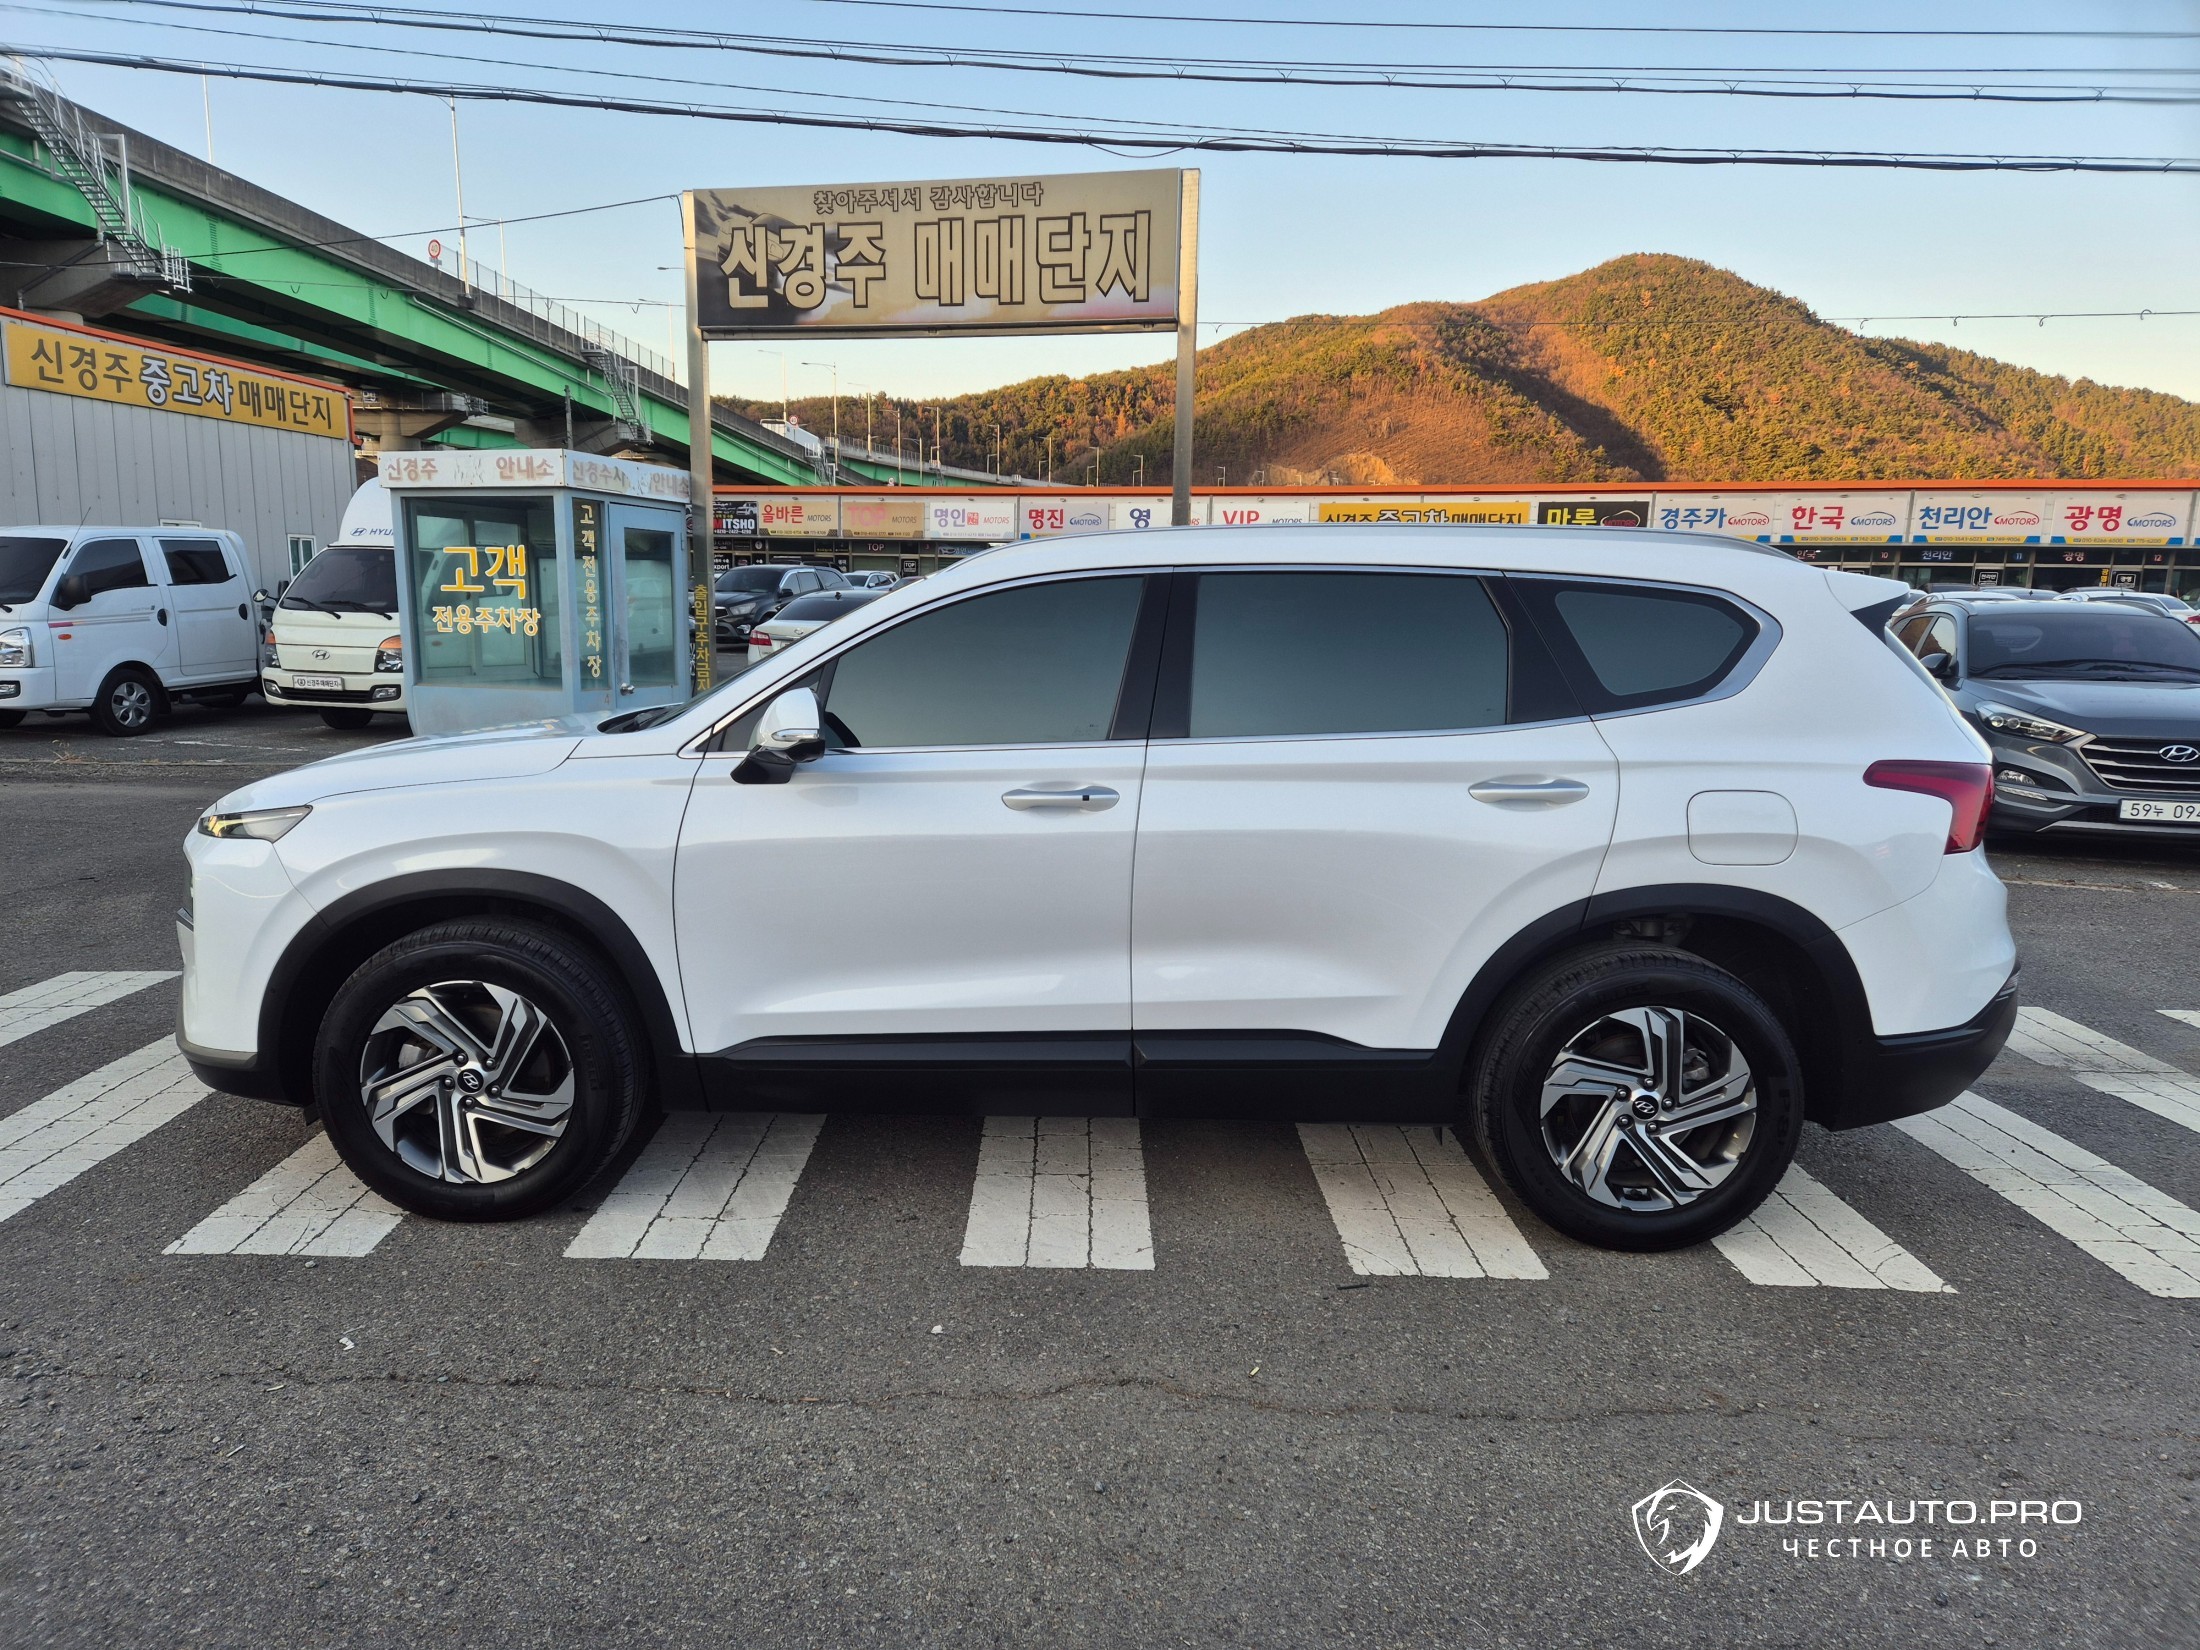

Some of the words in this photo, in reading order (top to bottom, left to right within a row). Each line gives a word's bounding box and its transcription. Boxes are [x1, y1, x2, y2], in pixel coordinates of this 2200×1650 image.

[814, 187, 922, 215] 찾아주셔서
[930, 182, 1044, 210] 감사합니다
[720, 220, 887, 310] 신경주
[914, 209, 1152, 307] 매매단지
[30, 338, 133, 394] 신경주
[140, 355, 234, 416] 중고차
[238, 379, 333, 430] 매매단지
[387, 457, 438, 481] 신경주
[496, 455, 554, 481] 안내소
[762, 504, 804, 524] 올바른
[807, 514, 832, 522] MOTORS
[847, 505, 888, 527] TOP
[892, 516, 917, 524] MOTORS
[934, 508, 966, 528] 명인
[983, 516, 1010, 524] MOTORS
[1028, 508, 1064, 530] 명진
[1073, 518, 1100, 526] MOTORS
[1222, 510, 1260, 525] VIP
[1547, 507, 1597, 526] 마루
[1661, 508, 1727, 529] 경주카
[1733, 518, 1767, 526] MOTORS
[1792, 506, 1845, 530] 한국
[1857, 517, 1893, 526] MOTORS
[1919, 506, 1993, 530] 천리안
[2000, 517, 2036, 525] MOTORS
[2064, 505, 2122, 531] 광명
[2133, 519, 2174, 527] MOTORS
[369, 528, 394, 536] HYU
[868, 543, 885, 551] TOP
[1881, 551, 1889, 559] 10
[1922, 550, 1953, 560] 천리안
[2063, 551, 2085, 562] 광명
[440, 544, 527, 600] 고객
[713, 562, 730, 570] xport
[432, 604, 542, 637] 전용주차장
[2130, 803, 2164, 818] 59누
